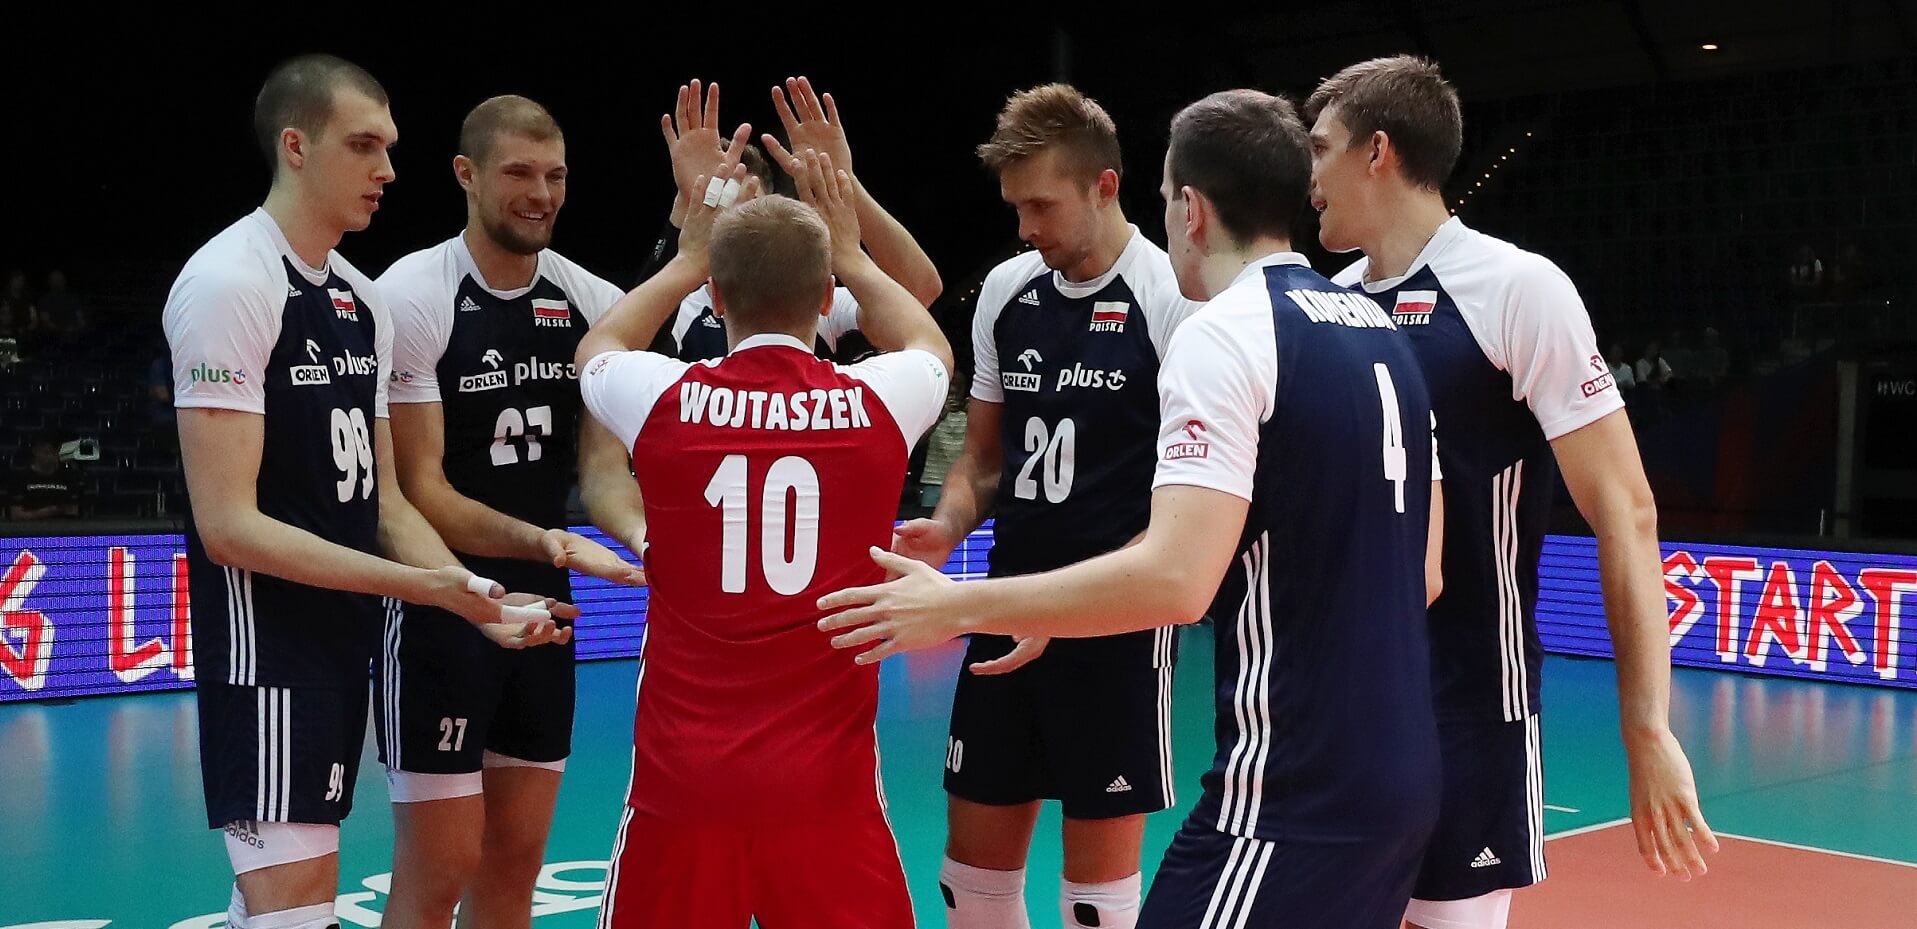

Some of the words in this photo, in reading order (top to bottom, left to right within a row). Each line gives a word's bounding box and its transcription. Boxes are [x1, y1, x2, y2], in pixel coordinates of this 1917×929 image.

[1089, 322, 1124, 333] POLSKA
[191, 363, 231, 387] plus
[333, 349, 370, 376] plus
[514, 356, 563, 386] plus
[463, 376, 505, 390] ORLEN
[1004, 375, 1037, 389] ORLEN
[1056, 363, 1104, 392] plus
[680, 381, 872, 431] WOJTASZEK
[489, 405, 552, 467] 27
[1373, 362, 1407, 513] 4
[330, 407, 374, 504] 99
[1014, 416, 1075, 504] 20
[1165, 444, 1205, 458] ORLEN
[704, 454, 820, 595] 10
[438, 717, 467, 751] 27
[1471, 858, 1501, 868] adidas
